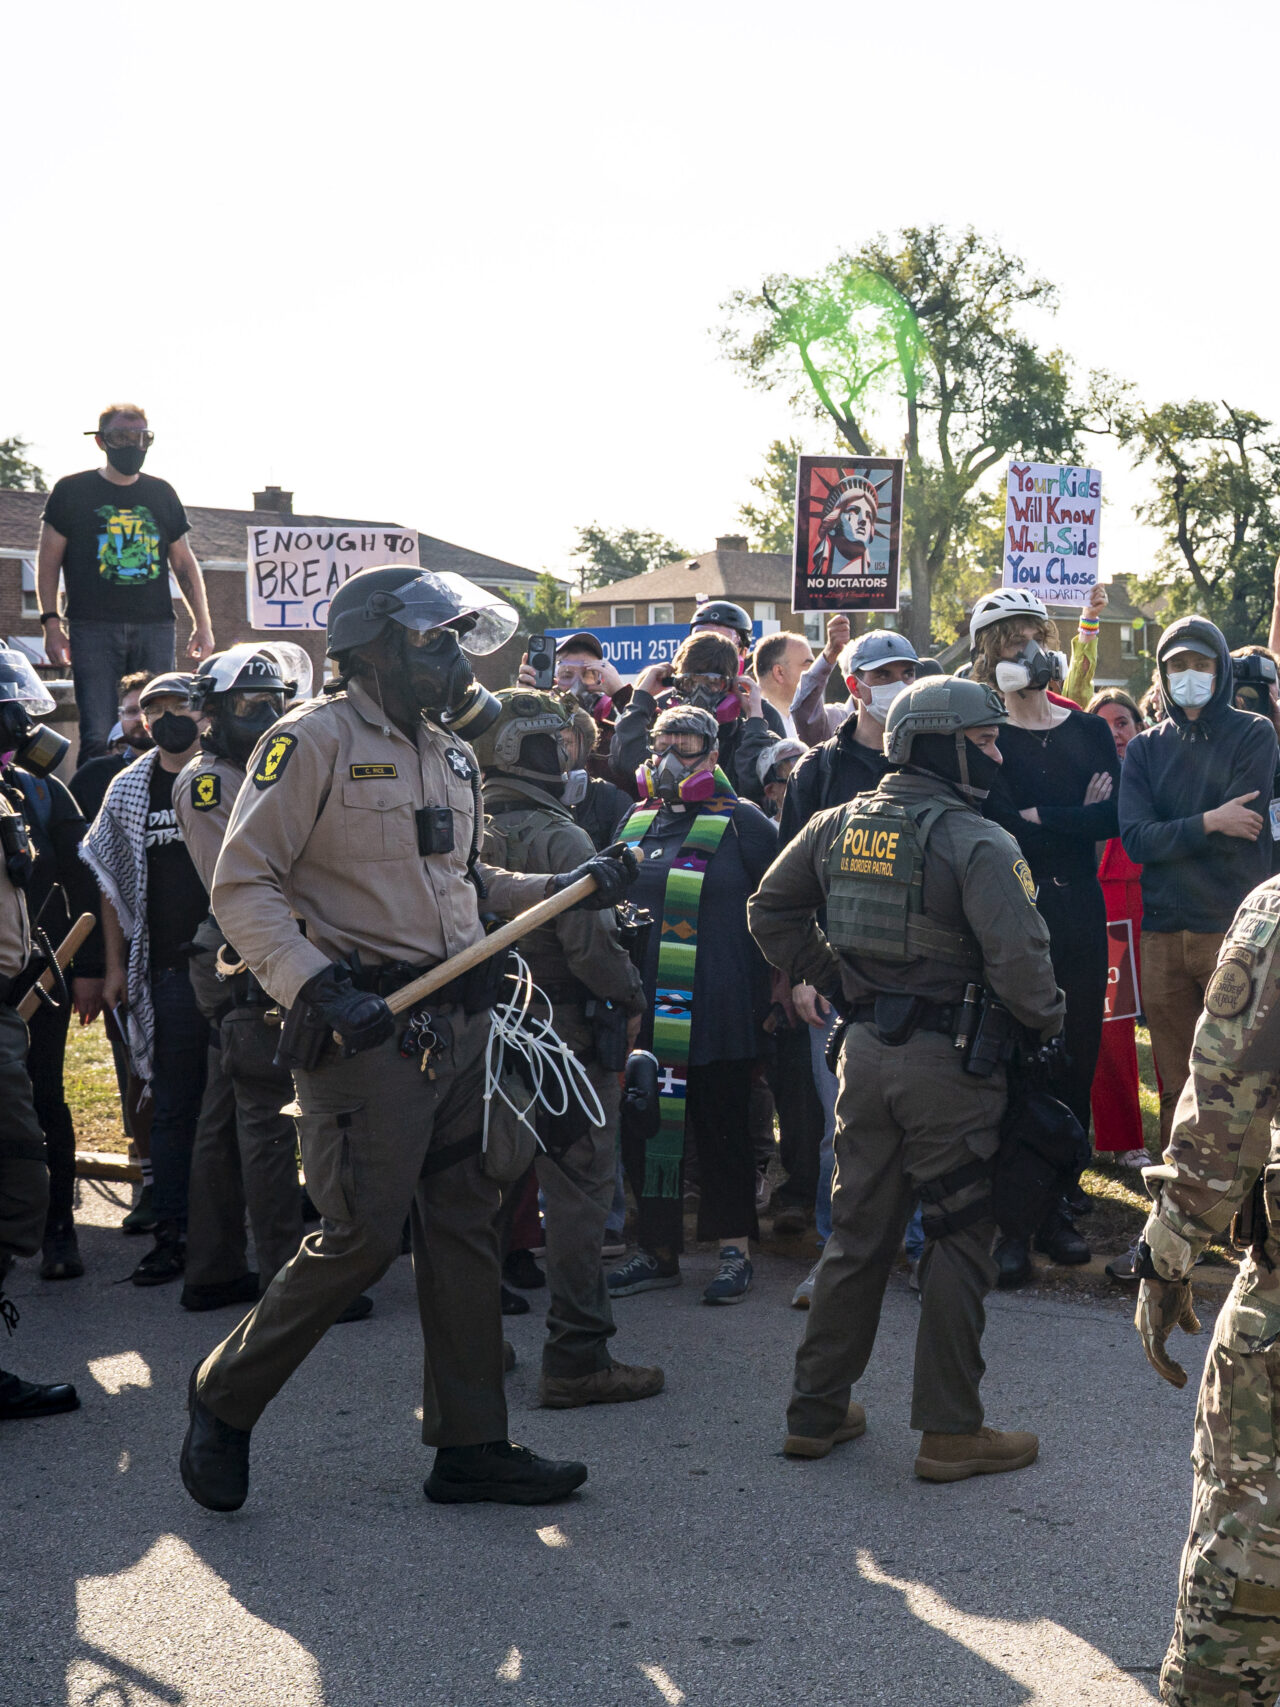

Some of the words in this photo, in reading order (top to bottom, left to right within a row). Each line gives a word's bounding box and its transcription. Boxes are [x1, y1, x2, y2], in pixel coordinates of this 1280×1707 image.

[1010, 496, 1043, 523] Will
[1046, 496, 1095, 526] Know
[254, 529, 376, 557] ENOUGH
[384, 533, 415, 555] TO
[1008, 525, 1055, 554] Which
[1055, 527, 1097, 558] Side
[807, 578, 825, 589] NO
[827, 577, 888, 589] DICTATORS
[1006, 554, 1041, 584] You
[1046, 557, 1097, 586] Chose
[842, 827, 899, 860] POLICE
[850, 858, 873, 874] BORDER
[872, 861, 894, 877] PATROL
